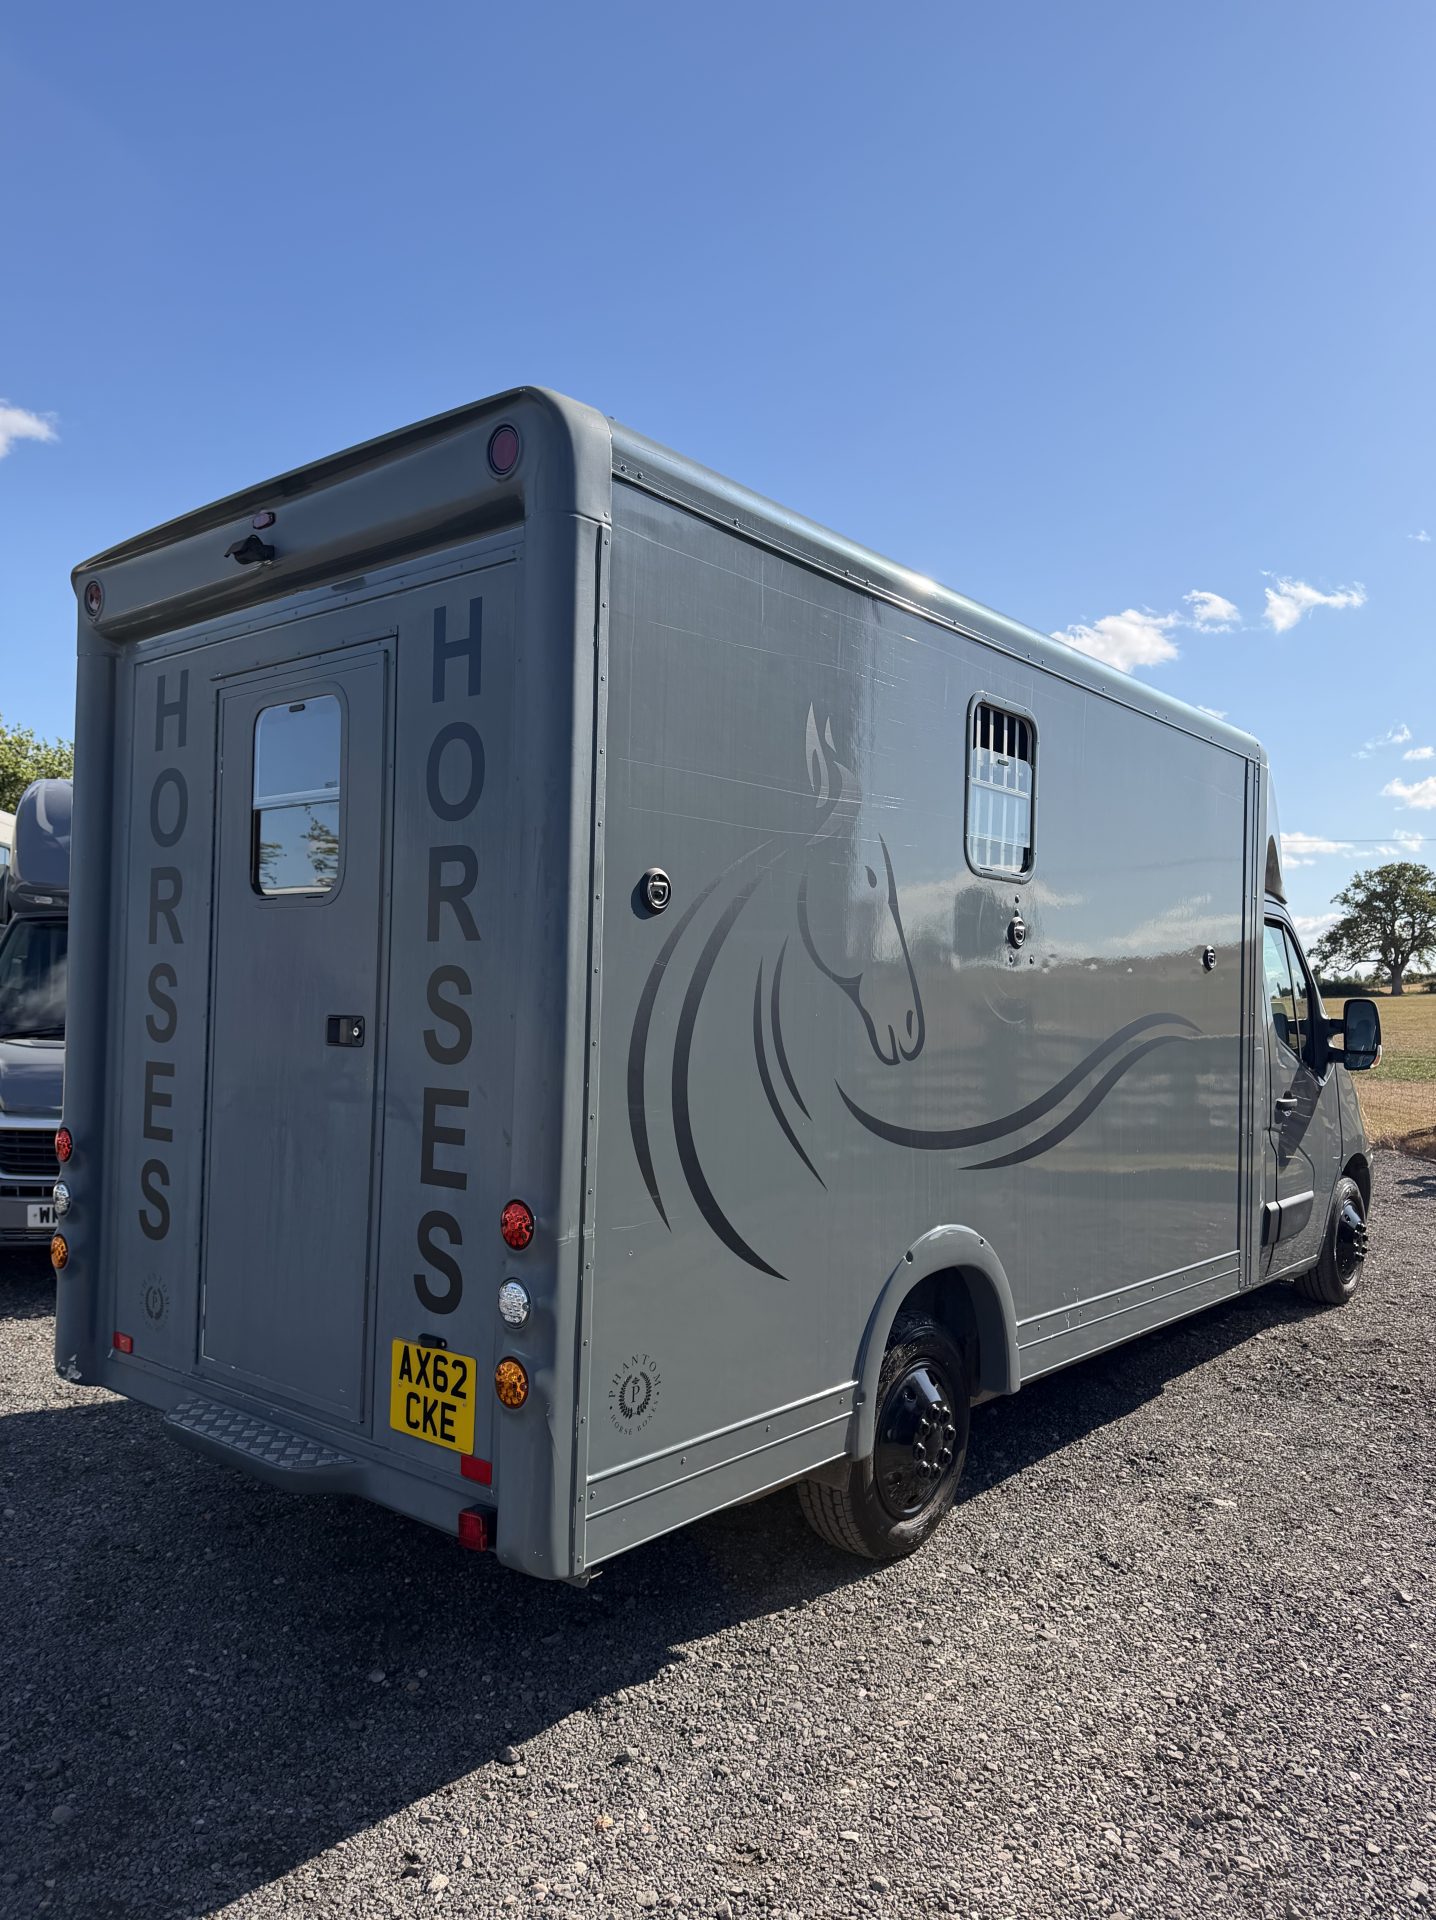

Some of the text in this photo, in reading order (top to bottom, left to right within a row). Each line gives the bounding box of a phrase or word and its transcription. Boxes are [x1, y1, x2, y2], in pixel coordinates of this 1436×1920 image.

[138, 669, 190, 1242] HORSES
[413, 596, 486, 1315] HORSES
[399, 1344, 468, 1400] AX62
[608, 1353, 662, 1398] PHANTOM
[630, 1385, 641, 1403] P
[405, 1391, 457, 1443] CKE
